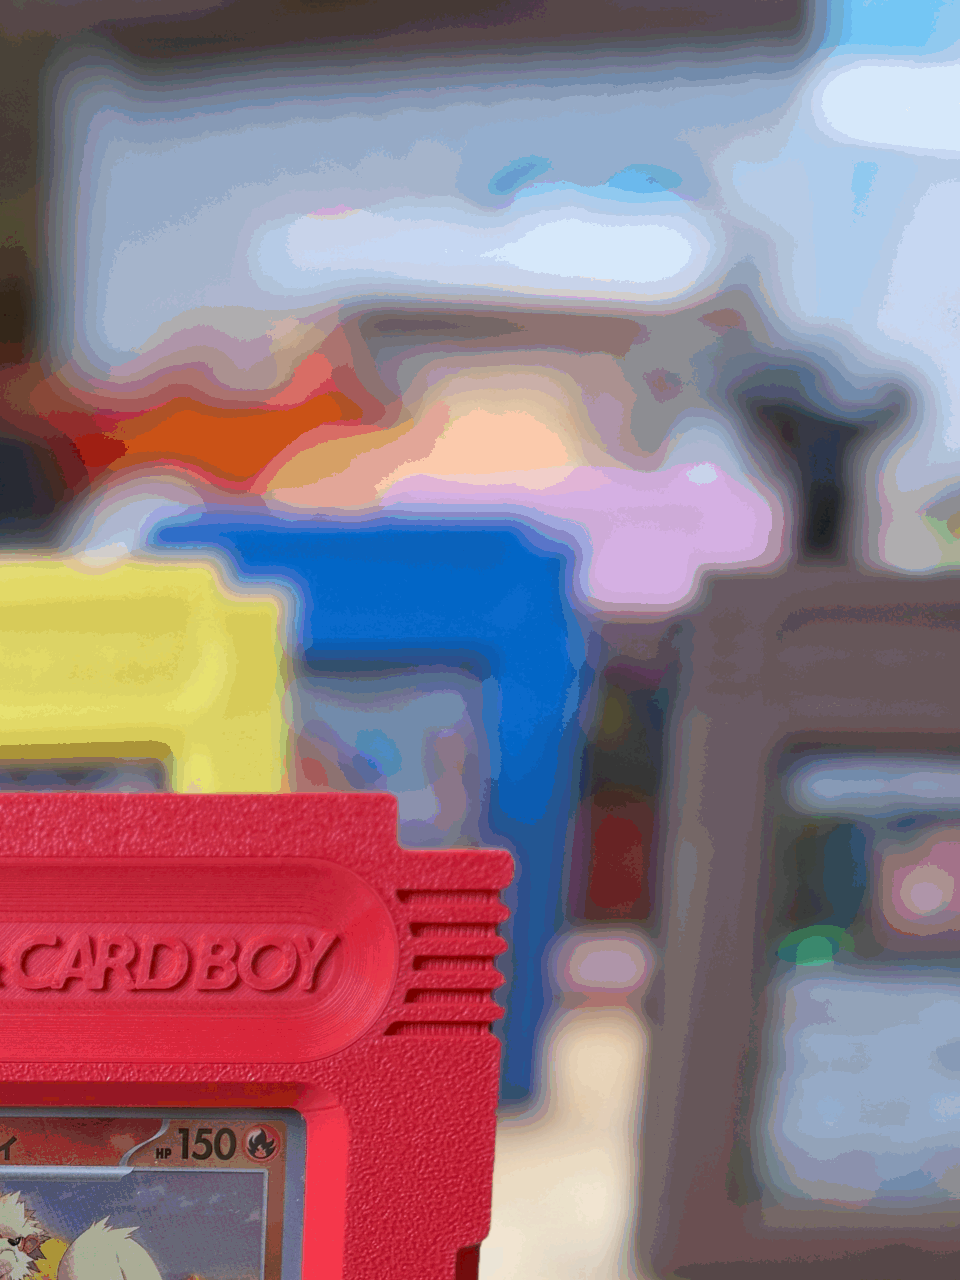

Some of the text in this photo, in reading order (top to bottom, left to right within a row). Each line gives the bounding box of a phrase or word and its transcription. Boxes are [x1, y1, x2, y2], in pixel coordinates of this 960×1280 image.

[8, 931, 341, 992] CARDBOY
[155, 1127, 237, 1161] HP 150
